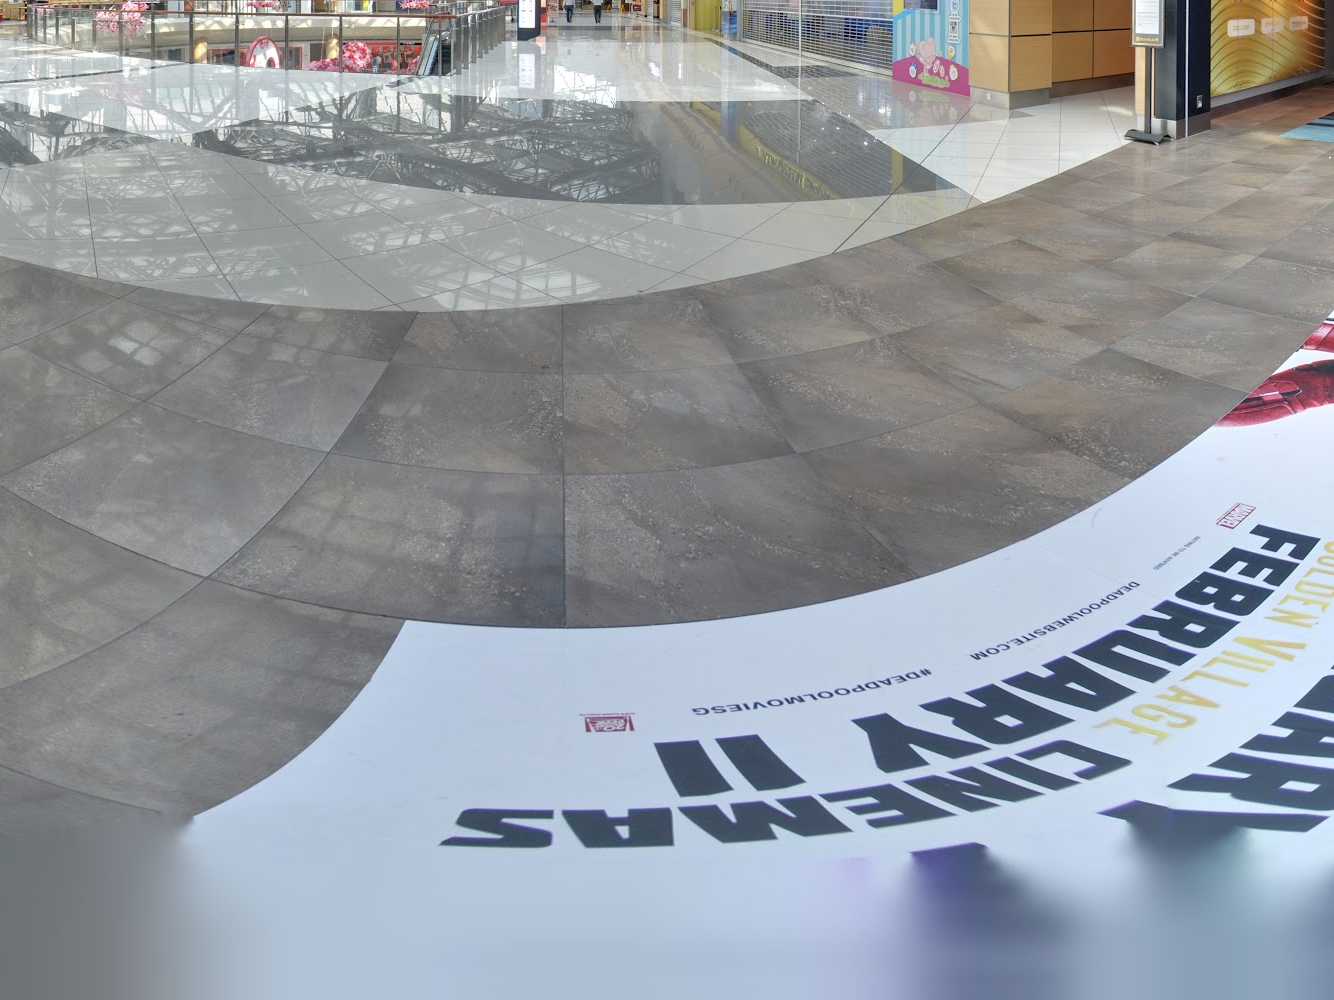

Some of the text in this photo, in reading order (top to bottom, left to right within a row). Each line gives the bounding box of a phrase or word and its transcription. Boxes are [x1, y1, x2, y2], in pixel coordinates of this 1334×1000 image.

[851, 524, 1322, 774] FEBRUARY
[969, 580, 1141, 662] DEADPOOLWEBSITE.COM
[691, 668, 933, 716] #DEADPOOLMOVIESG
[1091, 635, 1307, 746] VILLAGE
[438, 739, 1134, 849] CINEMAS
